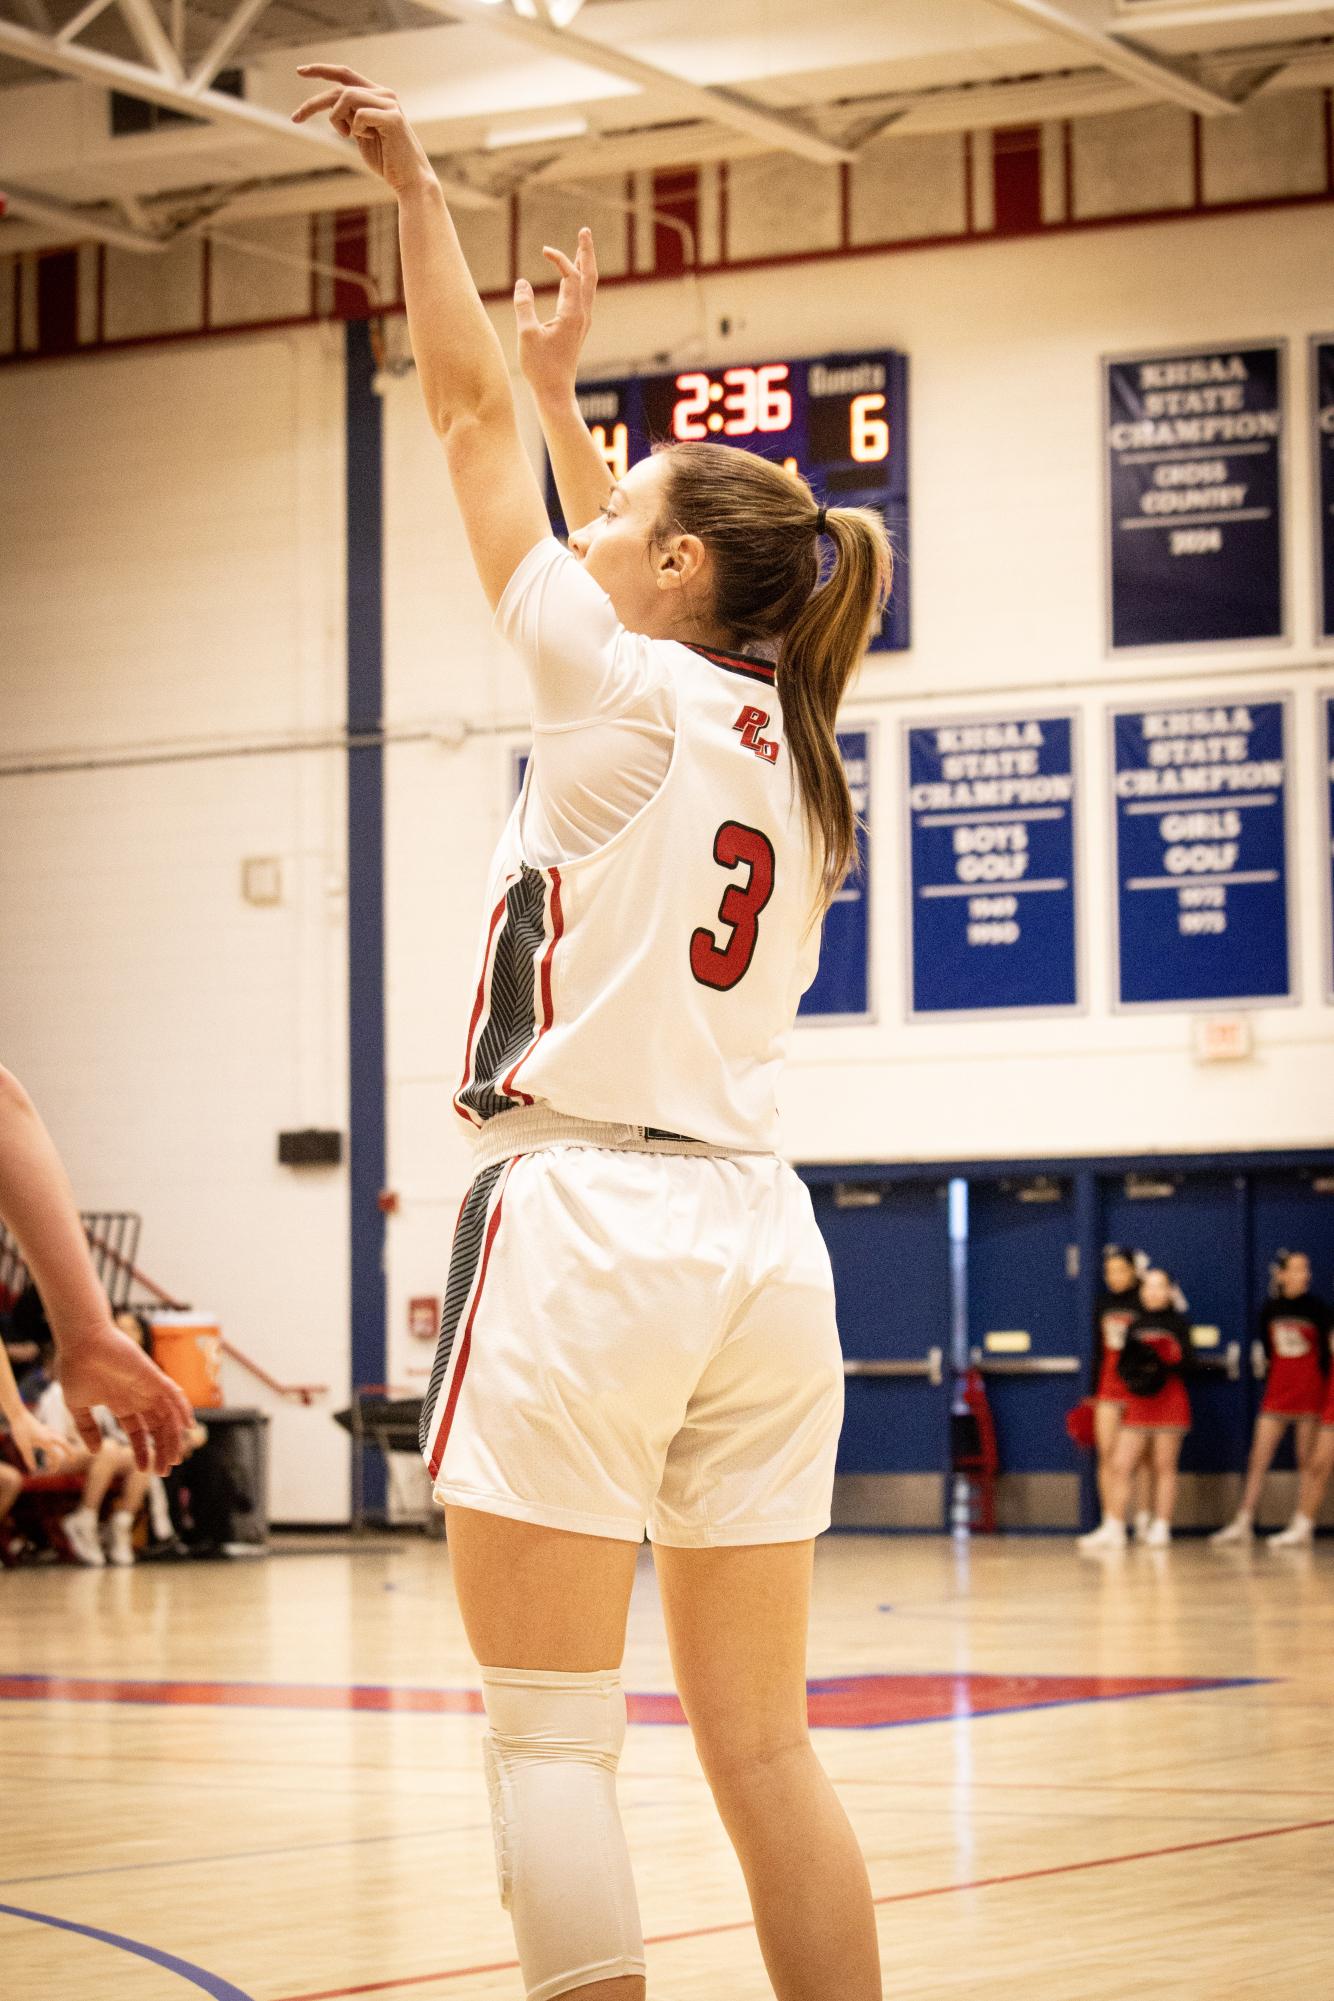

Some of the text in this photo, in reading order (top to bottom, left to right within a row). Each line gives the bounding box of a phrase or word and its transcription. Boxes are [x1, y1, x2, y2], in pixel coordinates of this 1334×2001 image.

[673, 364, 792, 440] 2:36
[1145, 384, 1244, 417] STATE
[850, 393, 889, 462] 6
[1110, 410, 1279, 450] CHAMPION
[942, 749, 1039, 781] STATE
[1148, 735, 1248, 767] STATE
[911, 775, 1073, 810] CHAMPION
[1116, 761, 1284, 798] CHAMPION
[953, 823, 1028, 855] BOYS
[1160, 811, 1241, 843] GIRLS
[956, 851, 1029, 882] GOLF
[1163, 842, 1239, 874] GOLF
[690, 820, 776, 992] 3
